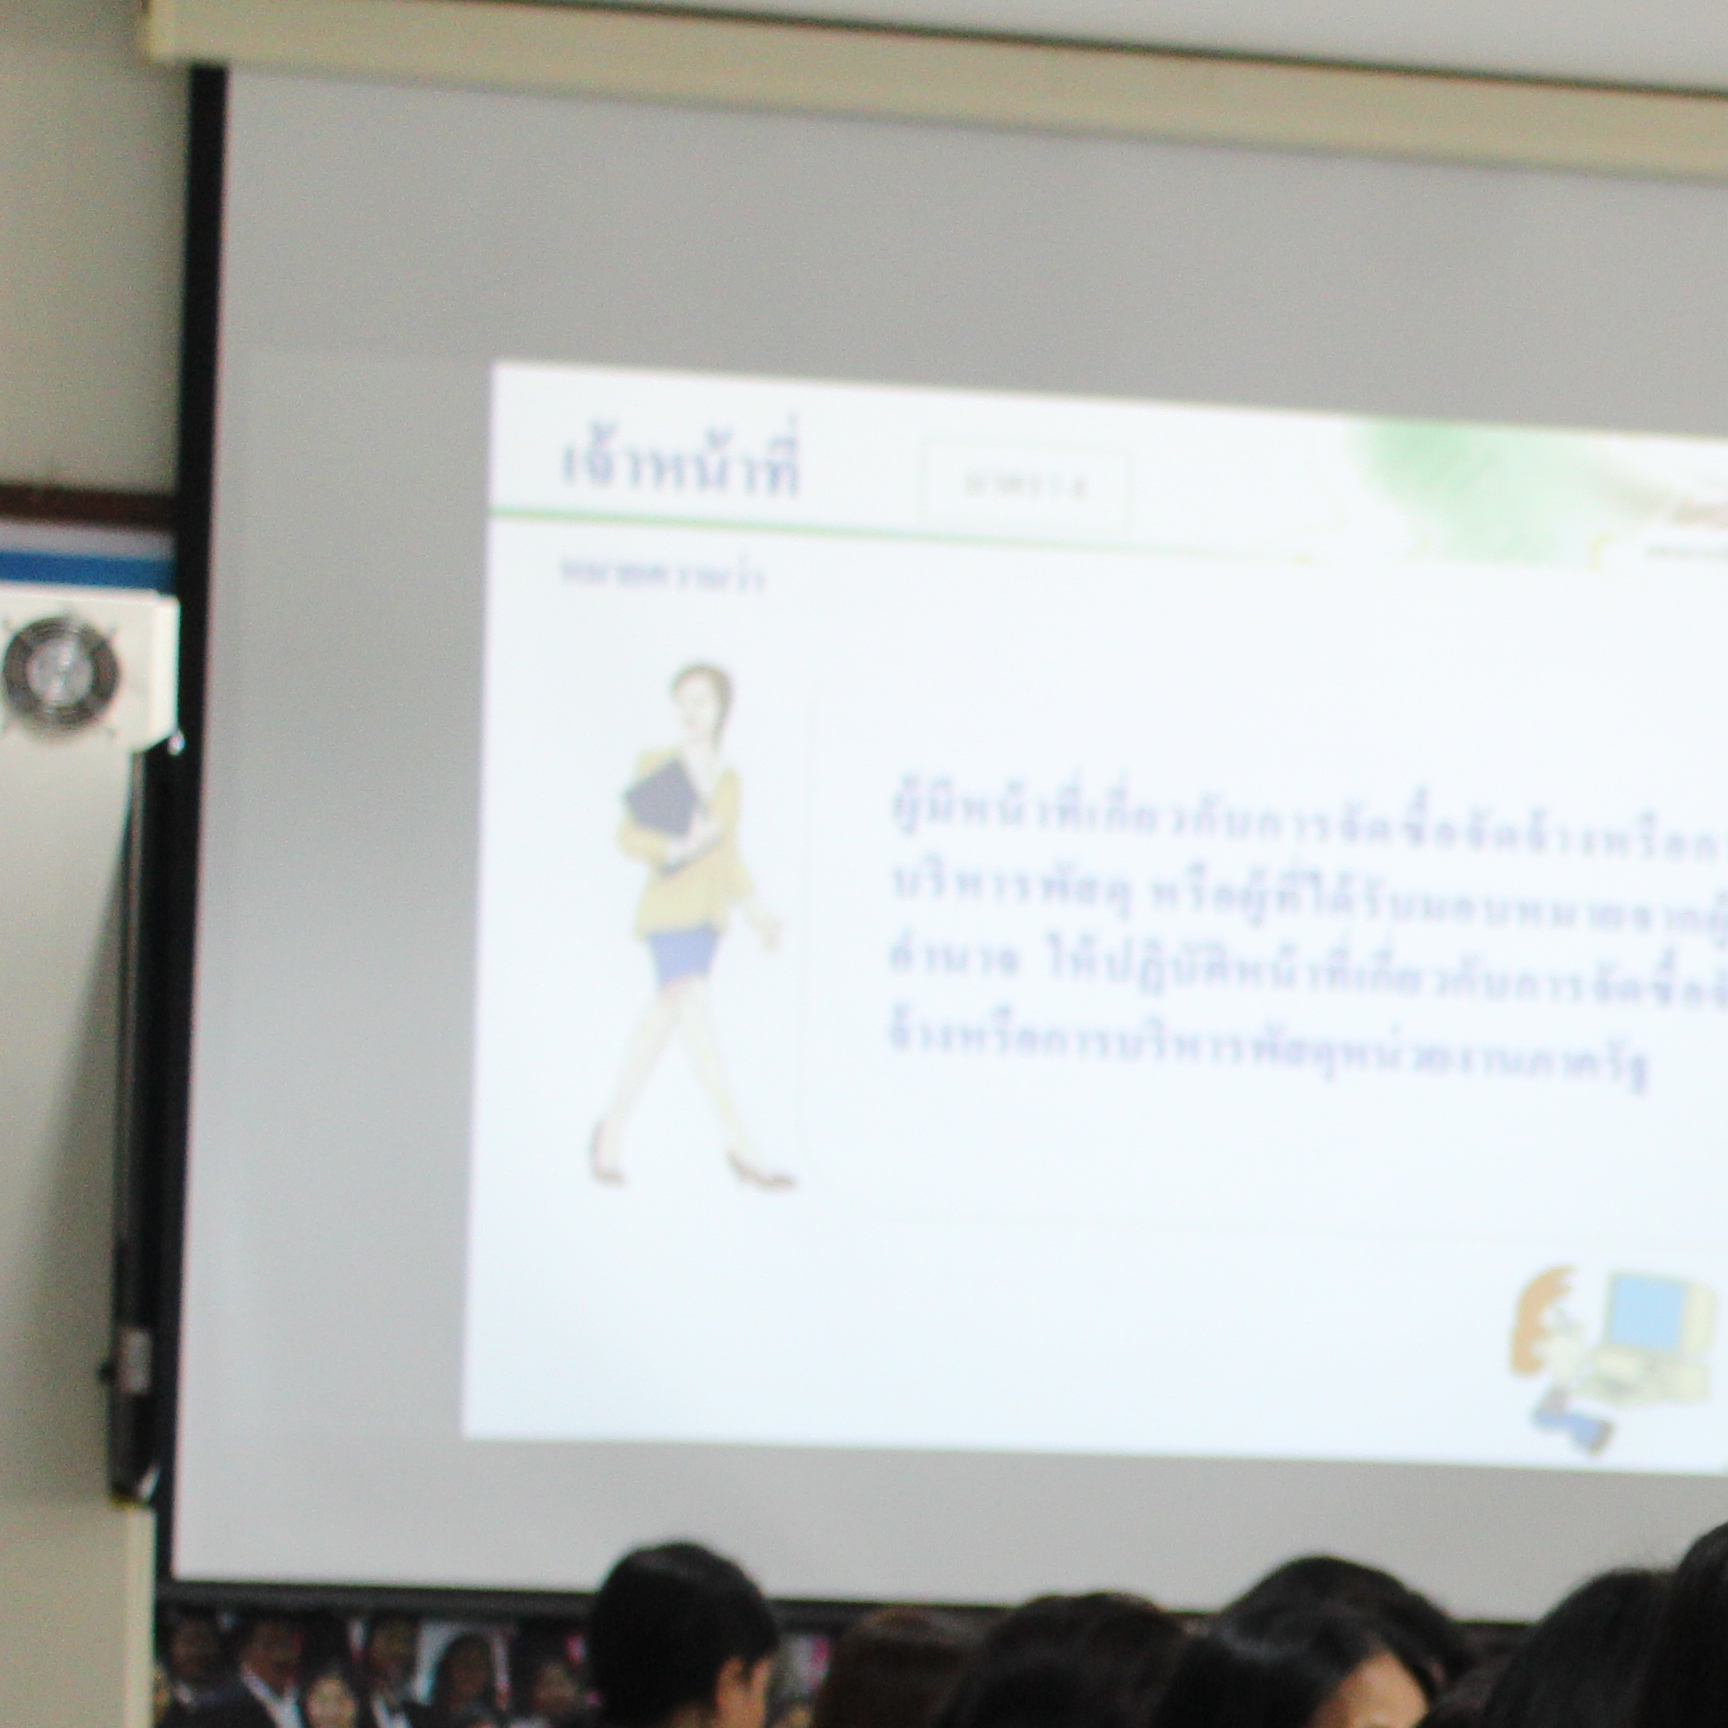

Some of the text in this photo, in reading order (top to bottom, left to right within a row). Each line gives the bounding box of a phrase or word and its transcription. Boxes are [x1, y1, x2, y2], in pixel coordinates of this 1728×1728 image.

[560, 414, 801, 499] เจ้าหน้าที่
